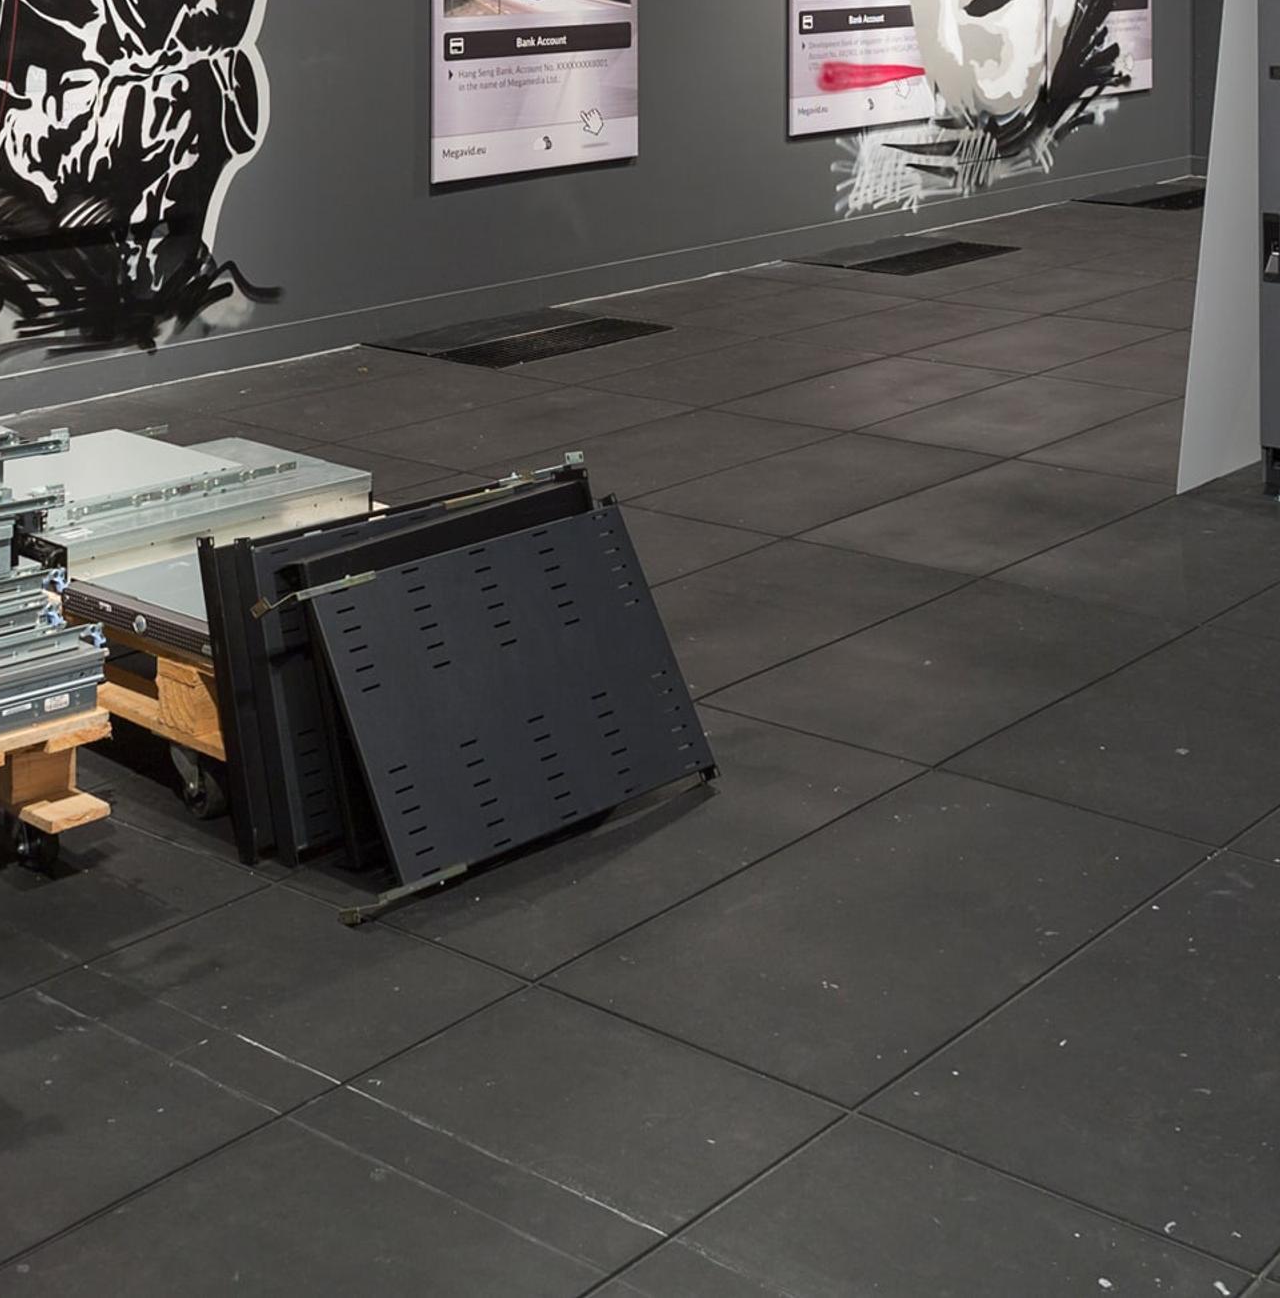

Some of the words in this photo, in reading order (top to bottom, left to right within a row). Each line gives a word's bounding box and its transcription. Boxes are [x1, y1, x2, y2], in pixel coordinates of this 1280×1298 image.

[848, 14, 862, 24] Bank
[863, 13, 885, 23] Account
[516, 36, 536, 48] Bank
[537, 35, 567, 46] Account
[458, 70, 477, 79] Hang
[478, 68, 494, 78] Seng
[515, 64, 542, 74] Account
[466, 81, 478, 90] the
[479, 81, 497, 89] name
[507, 75, 545, 88] Megamedia
[442, 145, 487, 160] Megavid.eu
